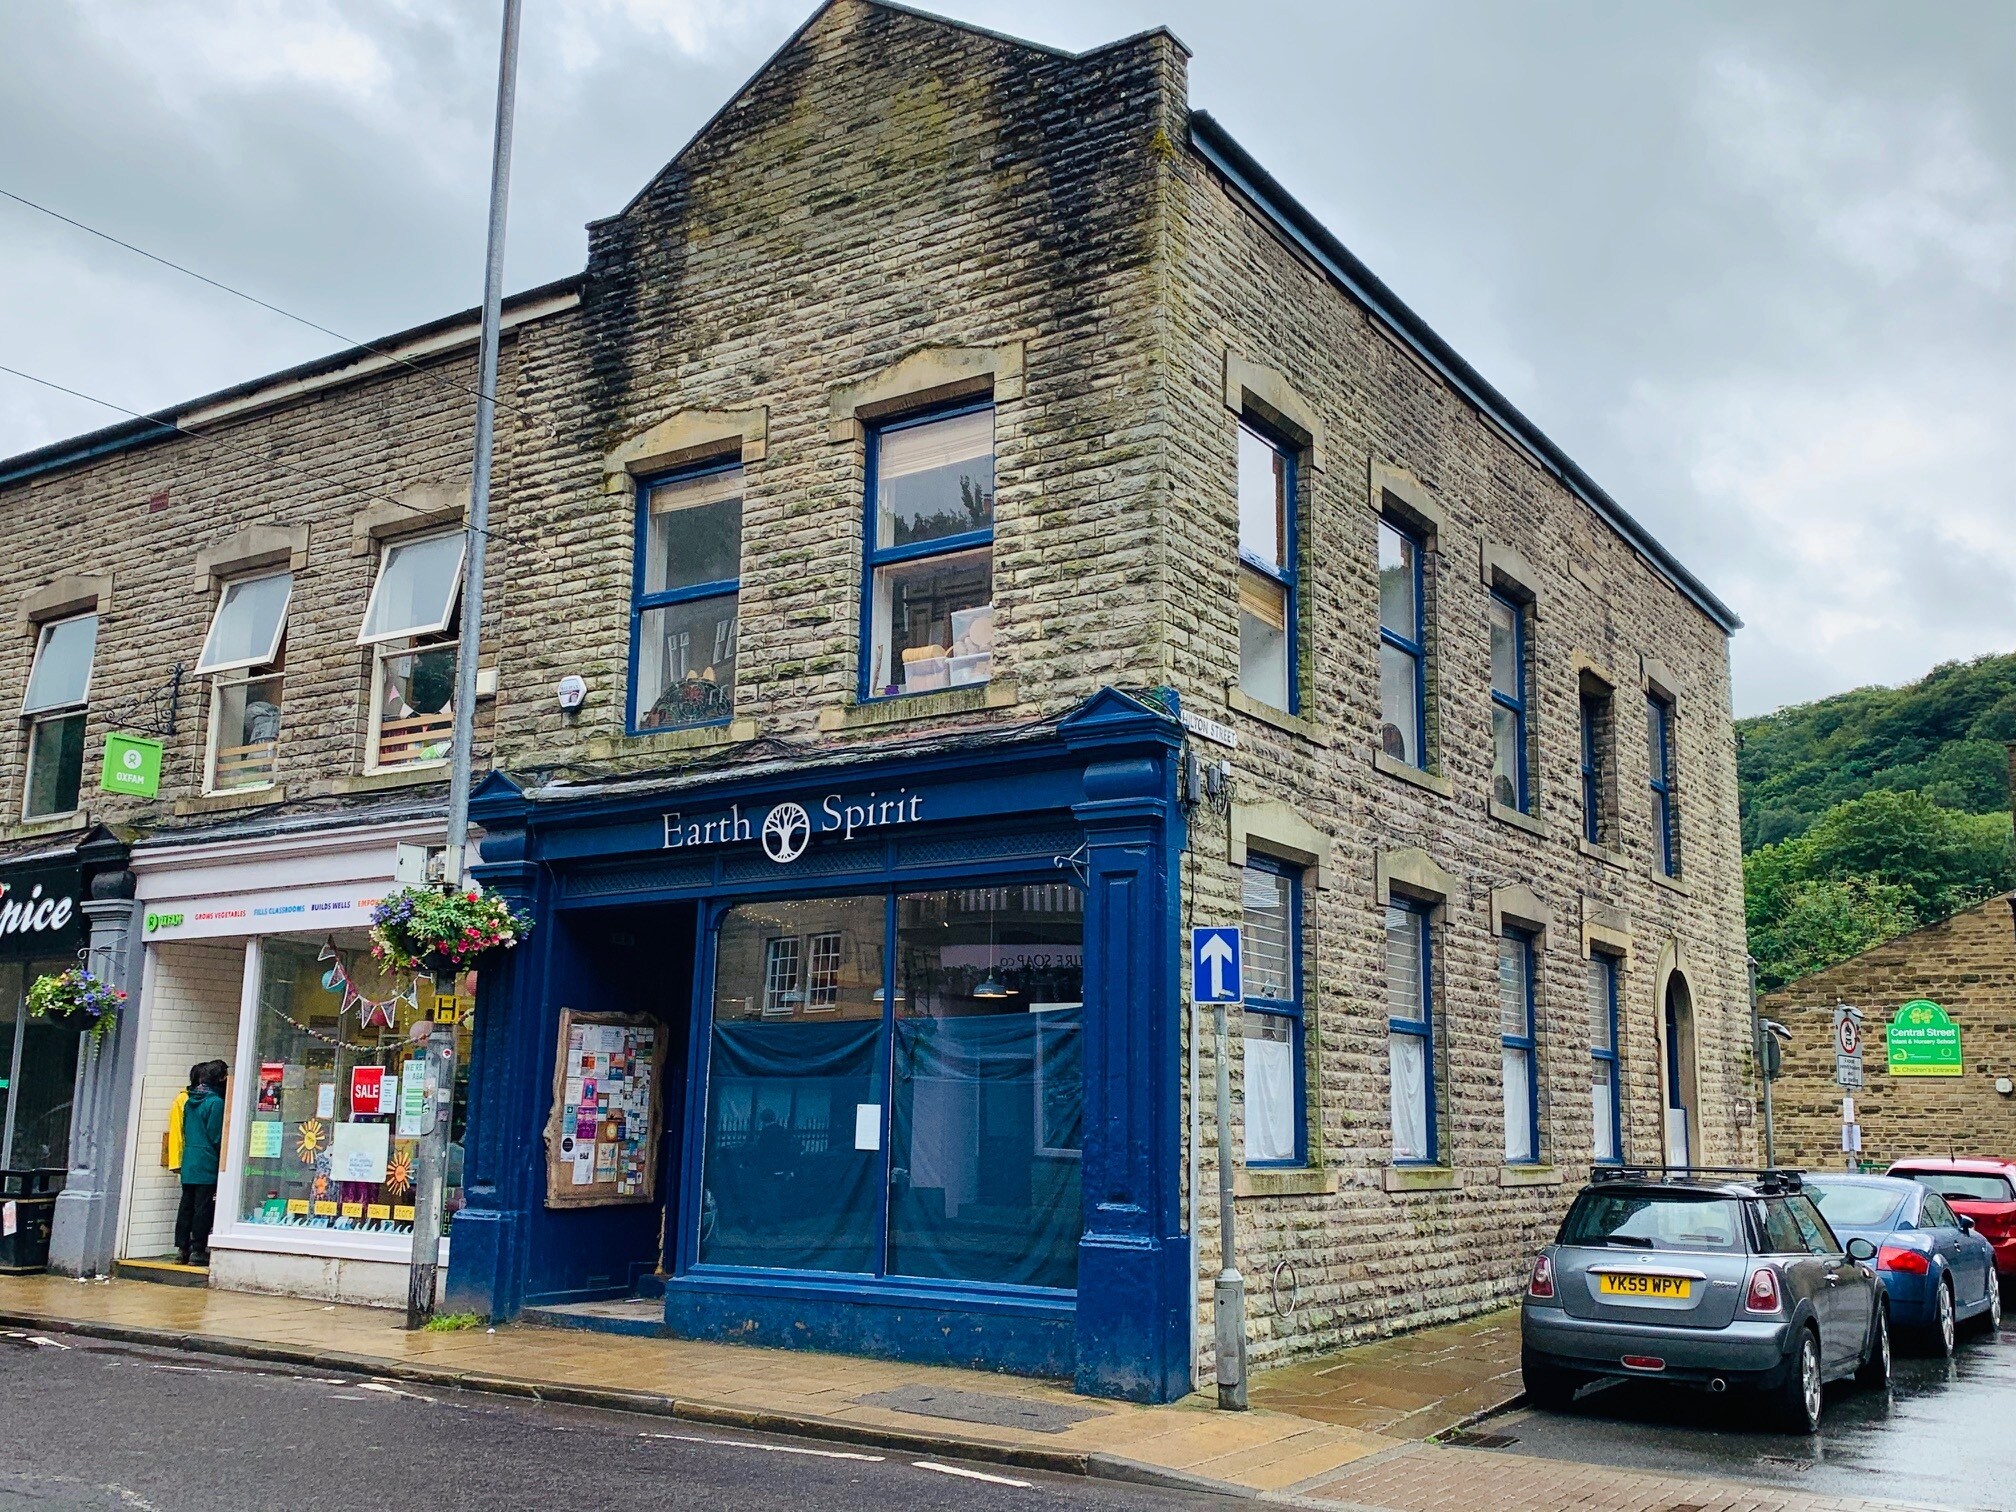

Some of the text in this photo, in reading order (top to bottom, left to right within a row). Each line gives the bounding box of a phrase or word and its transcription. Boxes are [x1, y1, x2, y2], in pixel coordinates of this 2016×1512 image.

[1211, 724, 1235, 744] STREET
[116, 772, 145, 784] OXFAM
[662, 788, 923, 849] Earth Spirit
[253, 905, 306, 916] FILLS CLASSROOMS
[311, 901, 351, 912] BUILDS WELLS
[160, 914, 184, 927] OXFAM
[194, 910, 247, 921] GROWS VEGETABLES
[438, 998, 457, 1020] H
[1891, 1028, 1956, 1037] Central Street
[1914, 1038, 1935, 1046] Nursery
[354, 1084, 380, 1099] SALE
[1608, 1276, 1684, 1295] YK59 WPY
